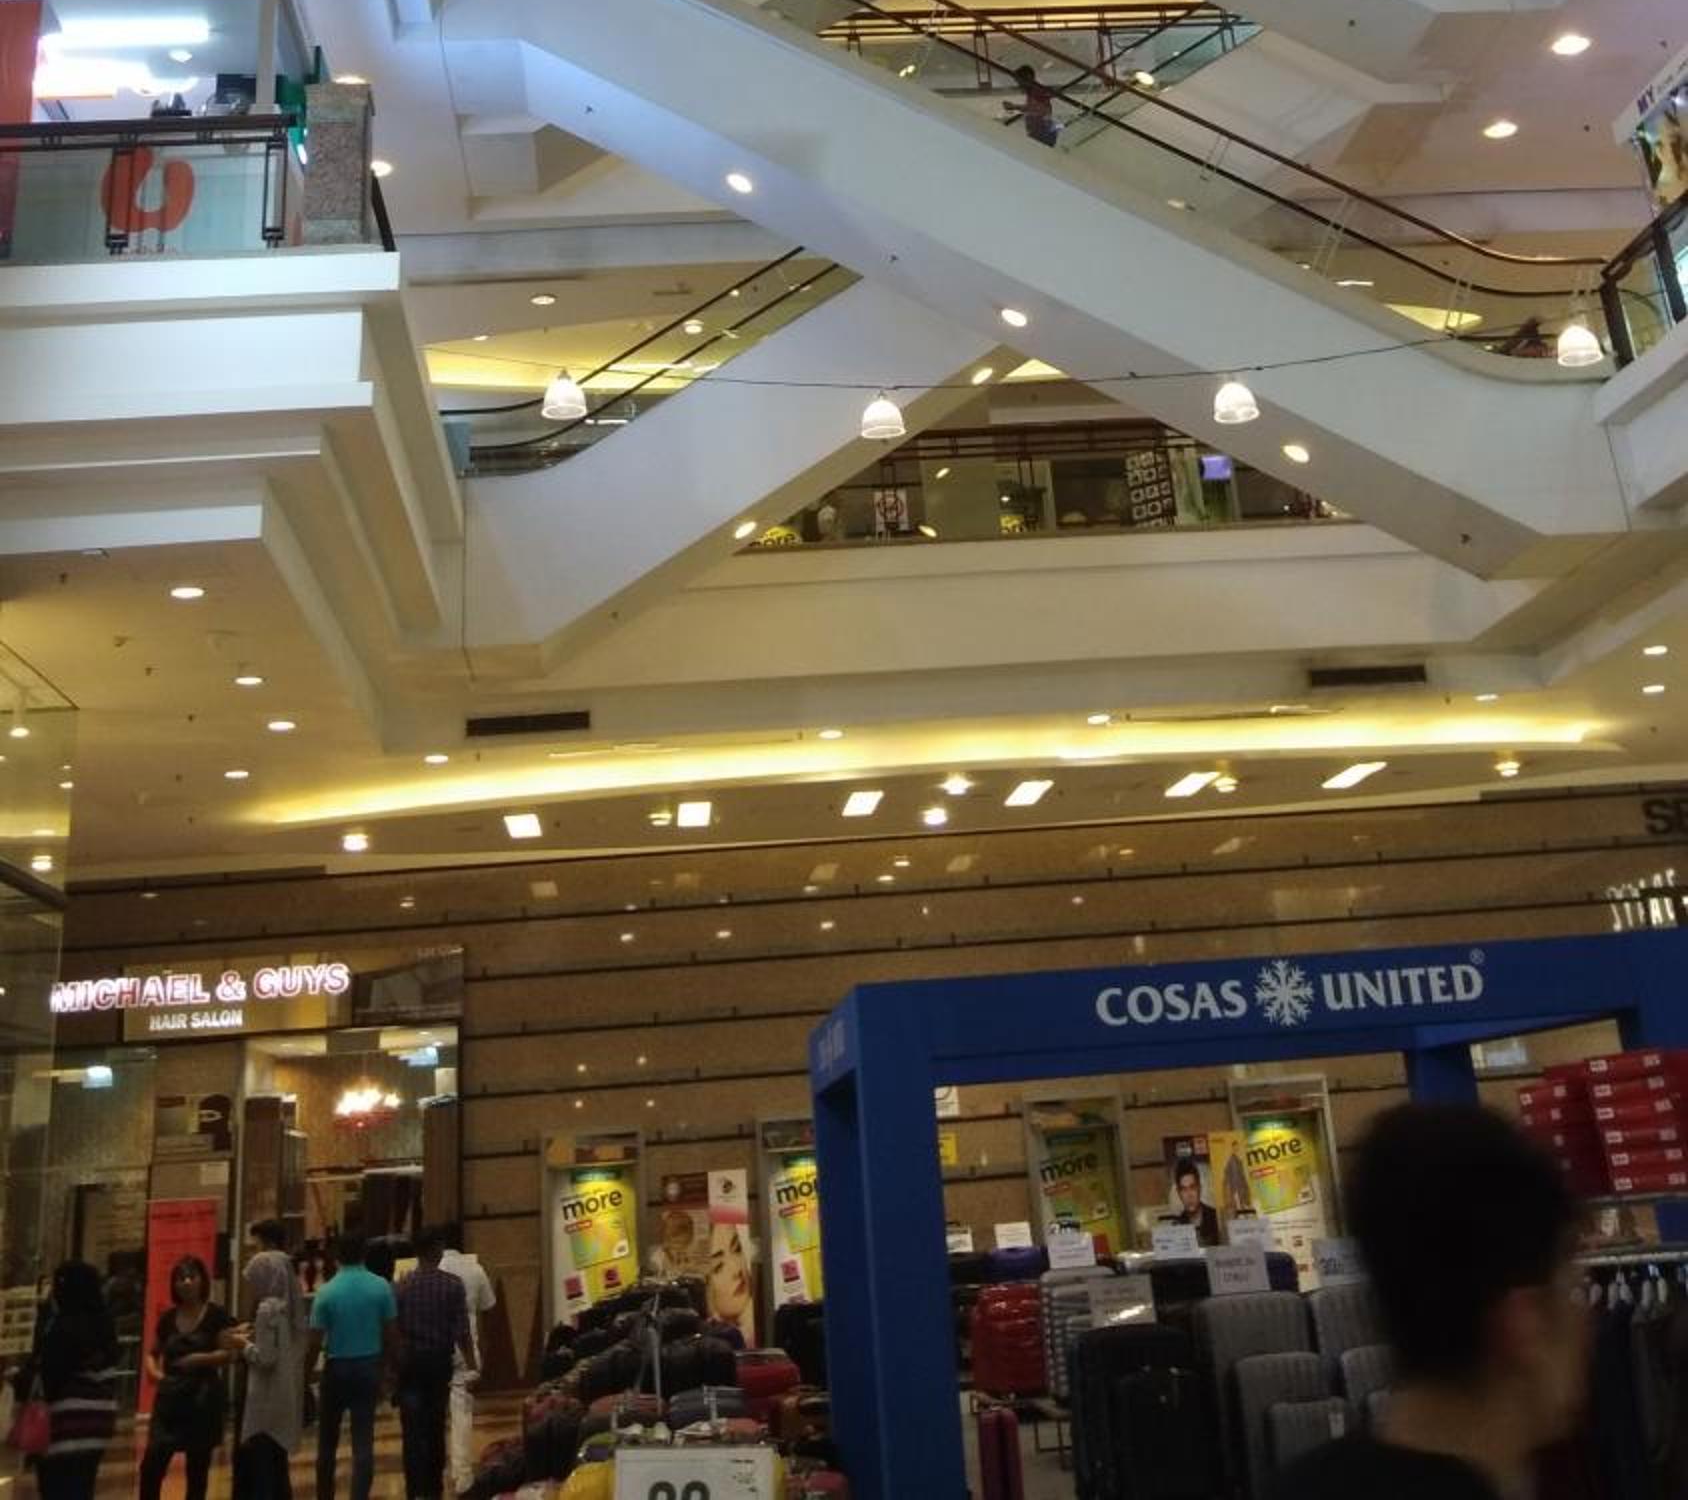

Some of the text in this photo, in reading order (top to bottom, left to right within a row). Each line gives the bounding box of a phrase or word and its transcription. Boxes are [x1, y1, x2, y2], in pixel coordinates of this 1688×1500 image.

[50, 963, 350, 1012] MICHAEL & GUYS
[1096, 964, 1484, 1026] COSAS UNITED
[149, 1008, 243, 1032] HAIR SALON
[1040, 1152, 1097, 1183] more
[1246, 1137, 1302, 1167] more
[562, 1190, 623, 1221] more
[776, 1178, 817, 1204] mo
